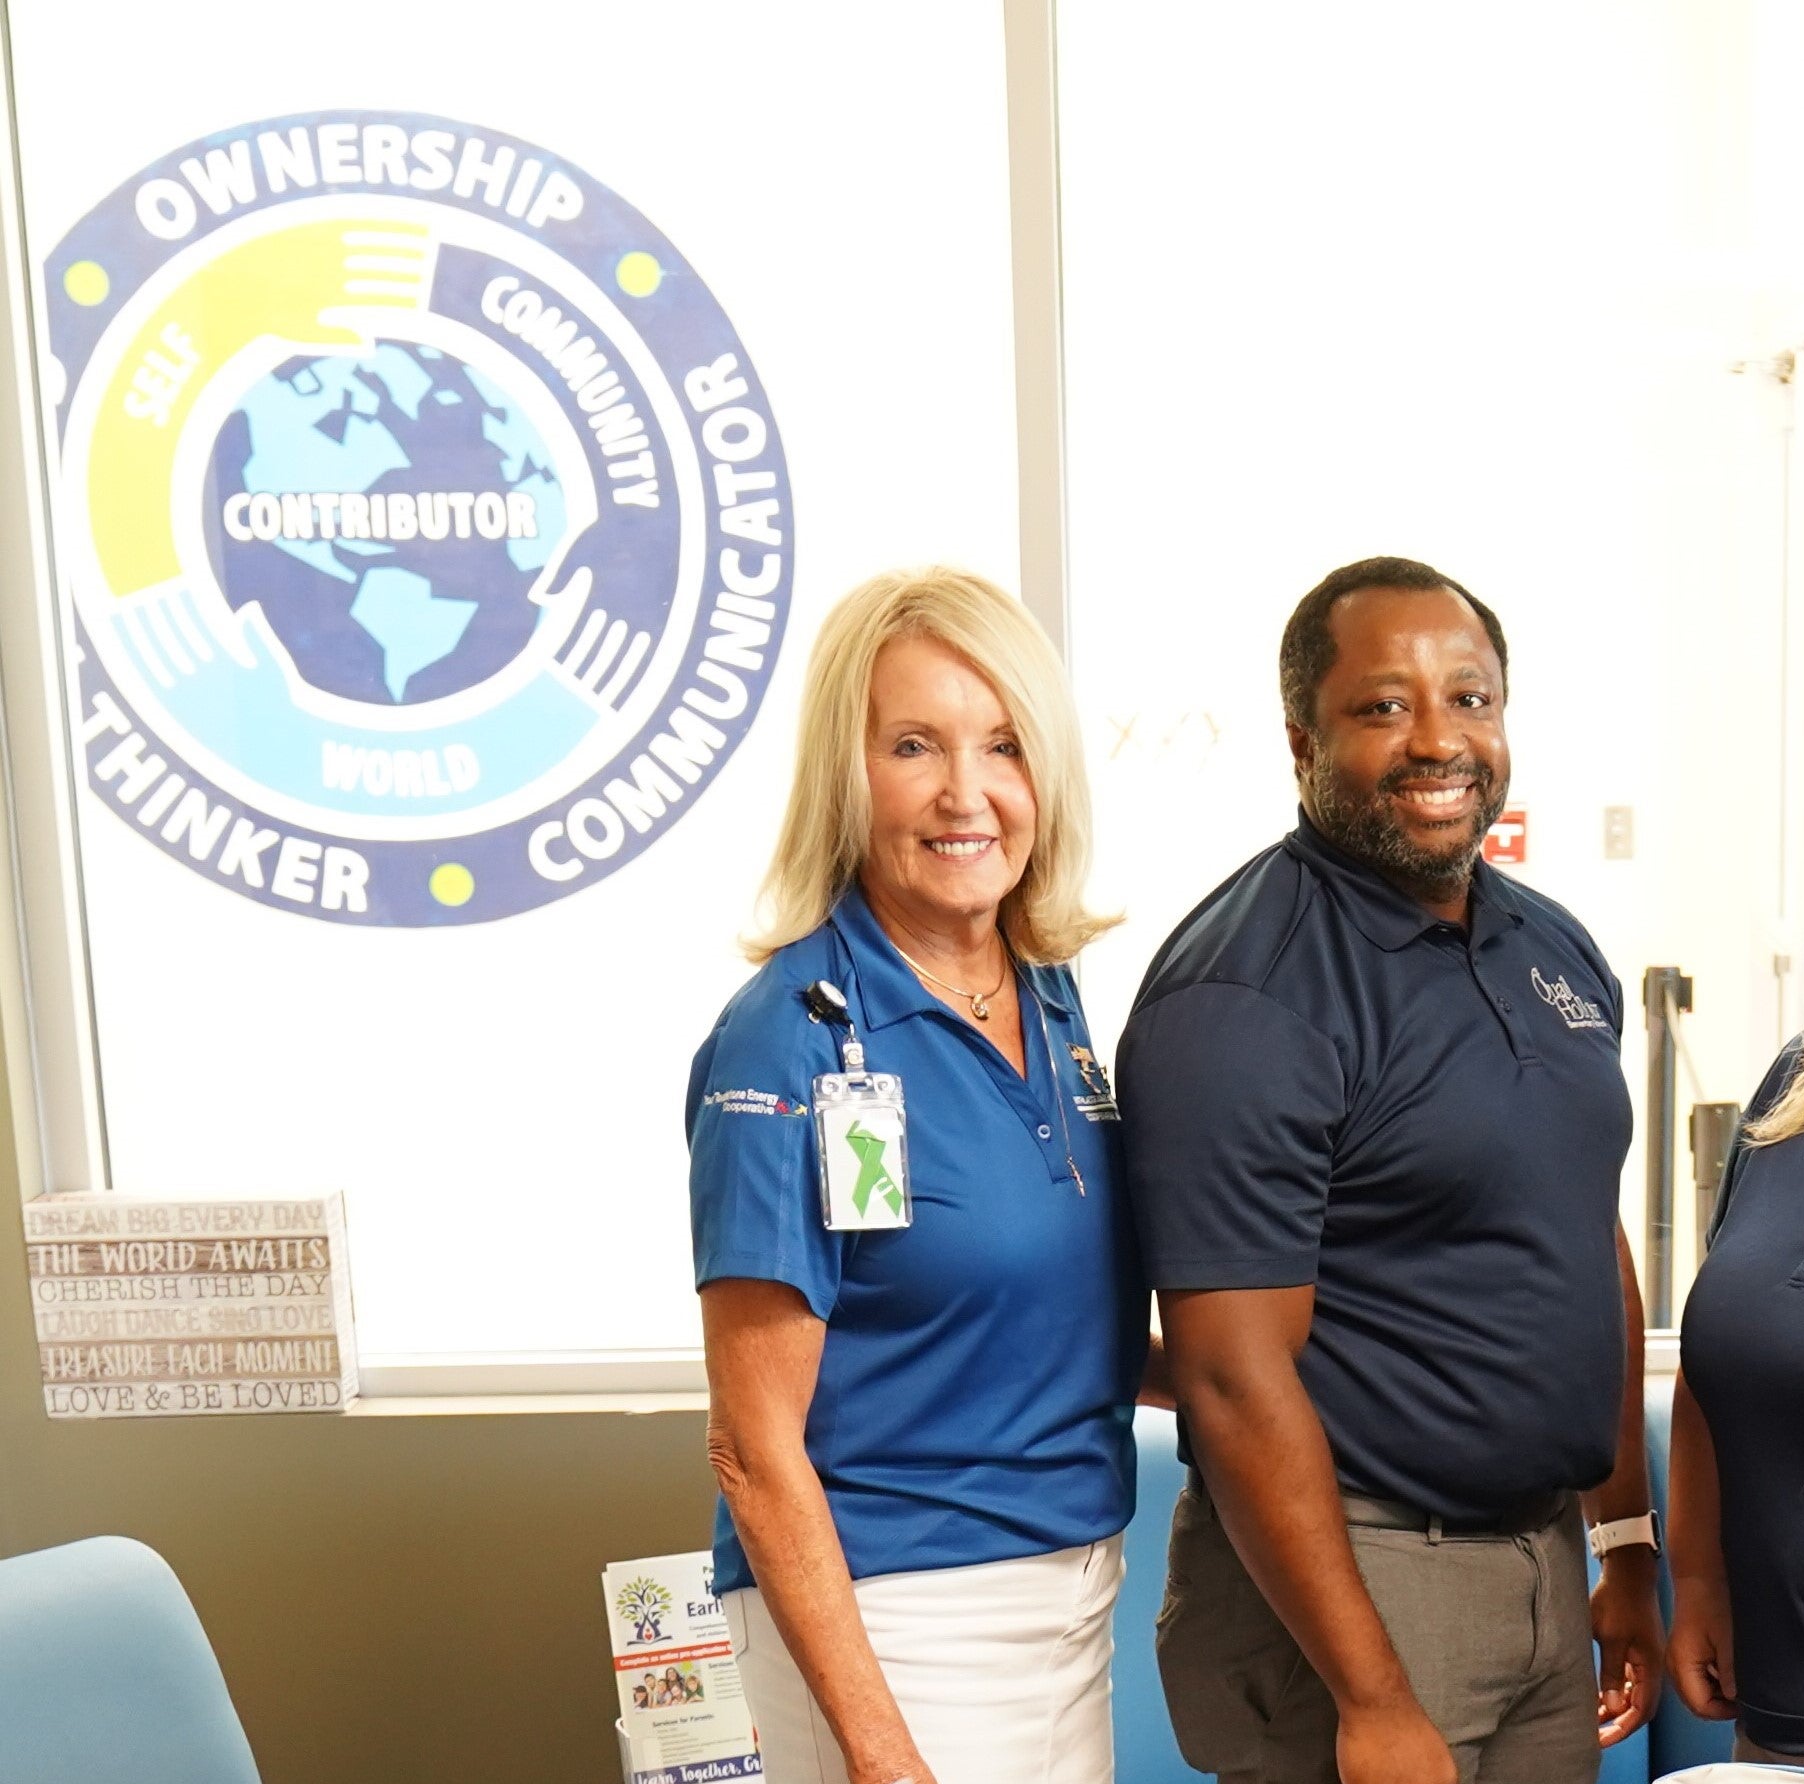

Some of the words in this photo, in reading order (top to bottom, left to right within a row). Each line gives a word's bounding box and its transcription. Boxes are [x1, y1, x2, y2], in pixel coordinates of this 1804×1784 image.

[135, 123, 584, 240] OWNERSHIP
[123, 322, 195, 428] SELF
[480, 275, 661, 509] COMMUNITY
[223, 491, 539, 543] CONTRIBUTOR
[527, 353, 782, 882] COMMUNICATOR
[321, 741, 480, 797] WORLD
[80, 692, 370, 914] THINKER
[30, 1207, 120, 1237] DREAM
[128, 1207, 170, 1234] BIG
[180, 1205, 265, 1231] EVERY
[273, 1203, 325, 1230] DAY
[36, 1244, 84, 1275] THE
[101, 1241, 198, 1274] WORLD
[208, 1238, 328, 1272] AWAITS
[37, 1277, 182, 1304] CHERISH
[190, 1275, 255, 1299] THE
[265, 1274, 328, 1297] DAY
[42, 1307, 118, 1338] LAUGH
[125, 1308, 200, 1334] DANCE
[269, 1304, 333, 1331] LOVE
[46, 1346, 152, 1379] TREASURE
[167, 1343, 224, 1376] EACH
[235, 1340, 334, 1374] MOMENT
[50, 1386, 135, 1414] LOVE
[145, 1384, 171, 1412] &
[180, 1383, 221, 1410] BE
[232, 1381, 342, 1408] LOVED
[679, 1762, 742, 1784] Together,
